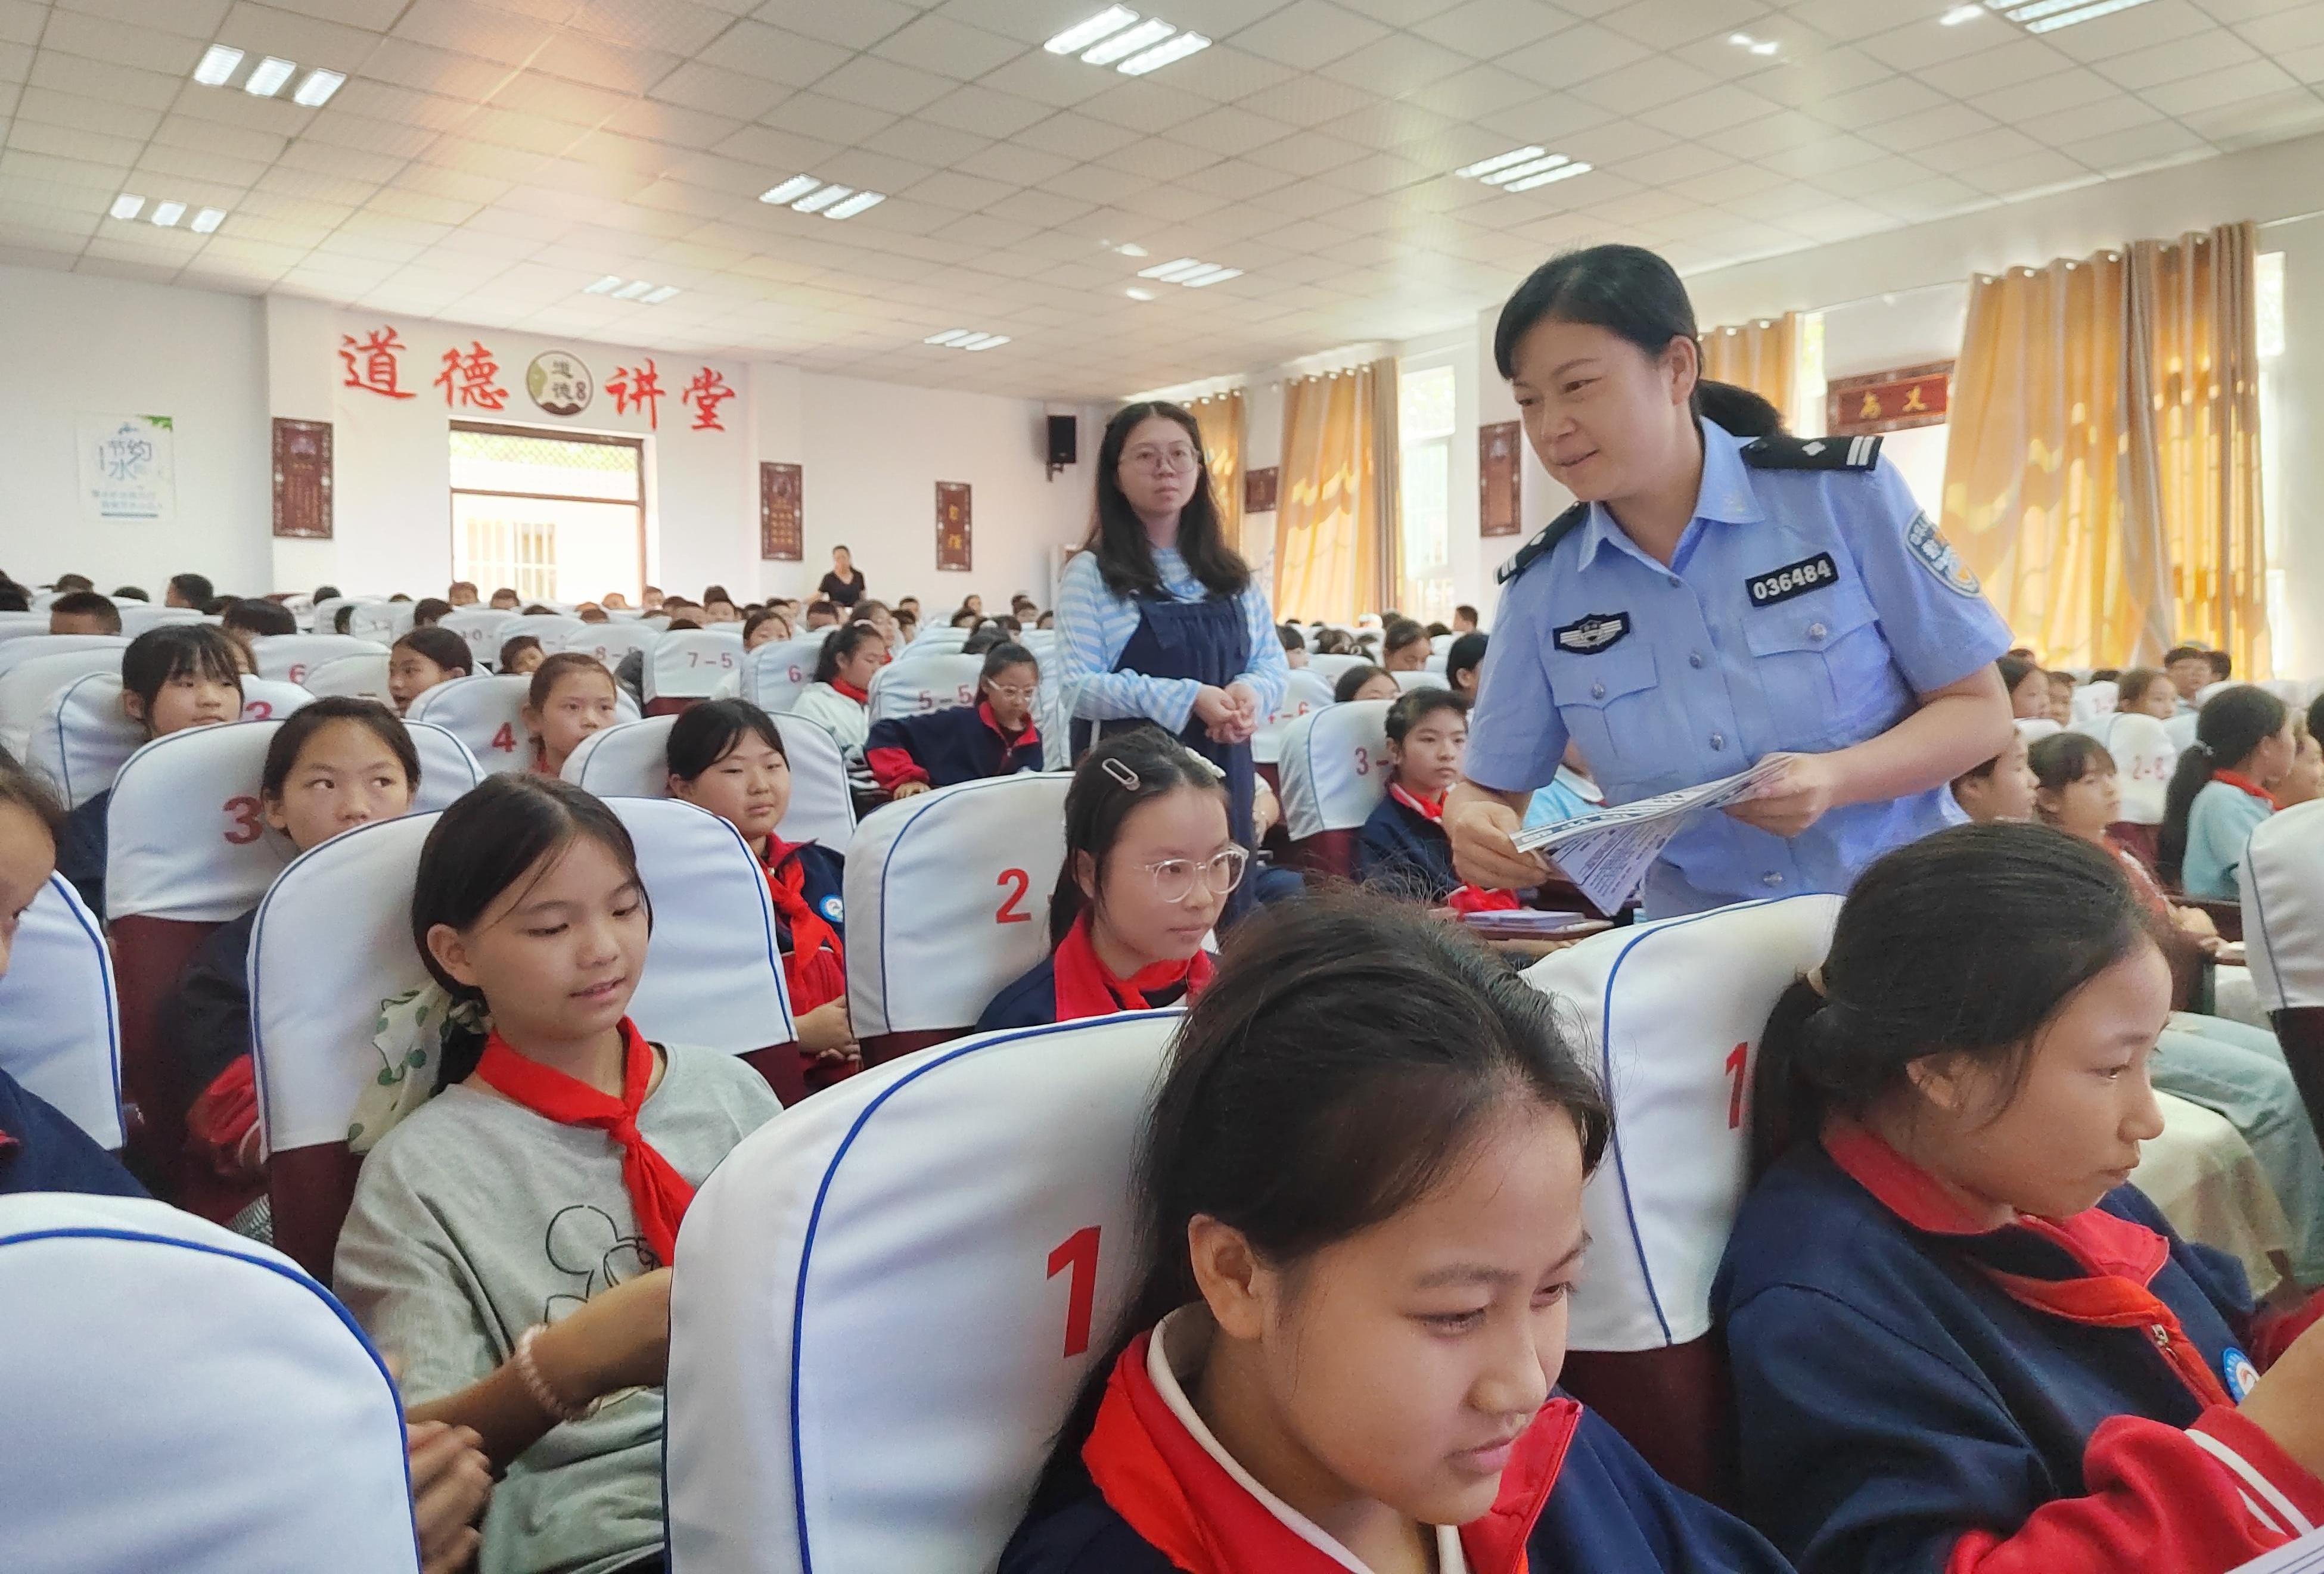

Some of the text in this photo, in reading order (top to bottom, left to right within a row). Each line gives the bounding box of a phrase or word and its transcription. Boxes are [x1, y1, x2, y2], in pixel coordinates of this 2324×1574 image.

[1753, 560, 1831, 599] 036484
[687, 651, 733, 668] 7-5
[919, 685, 974, 710] 5-5
[492, 721, 517, 752] 4
[223, 797, 262, 844] 3
[996, 868, 1031, 924] 2
[1725, 1041, 1748, 1129] 1
[1046, 1225, 1102, 1359] 1
